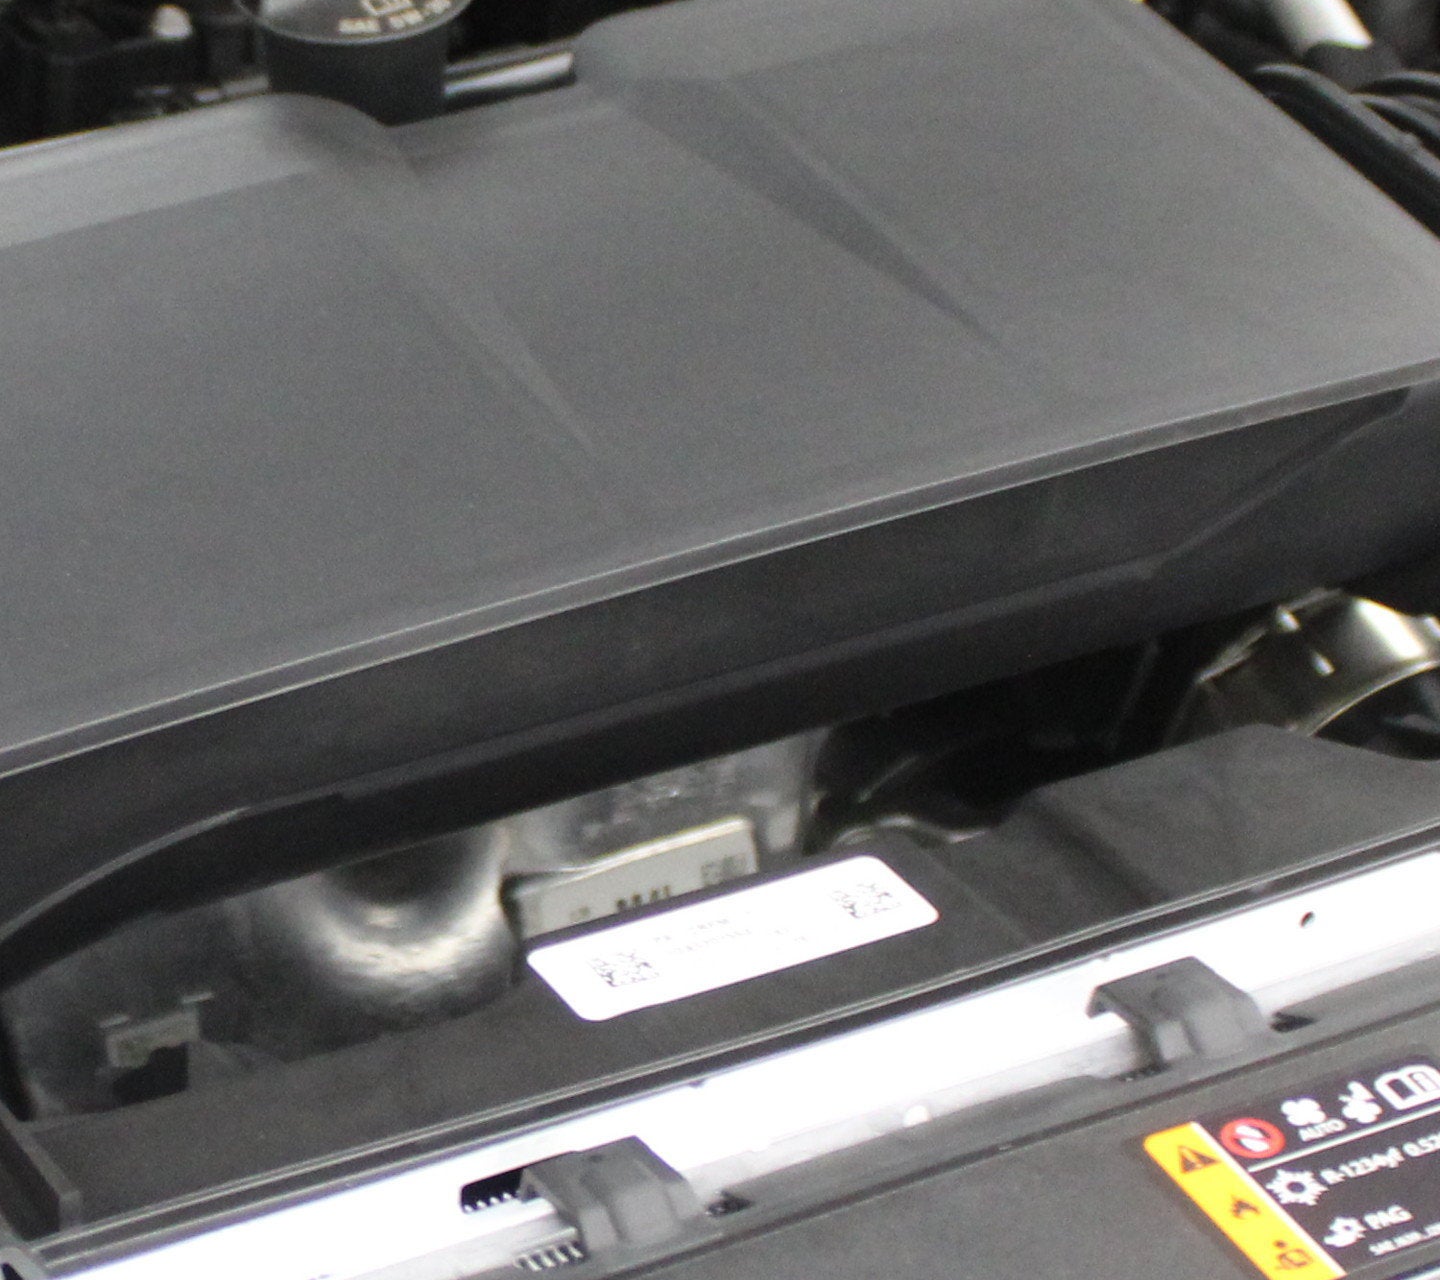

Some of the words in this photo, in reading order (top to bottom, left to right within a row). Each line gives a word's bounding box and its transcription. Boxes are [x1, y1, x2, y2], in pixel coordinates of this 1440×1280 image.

[1299, 1118, 1347, 1141] AUTO
[1321, 1146, 1405, 1185] R-1234yf
[1364, 1205, 1413, 1230] PAG
